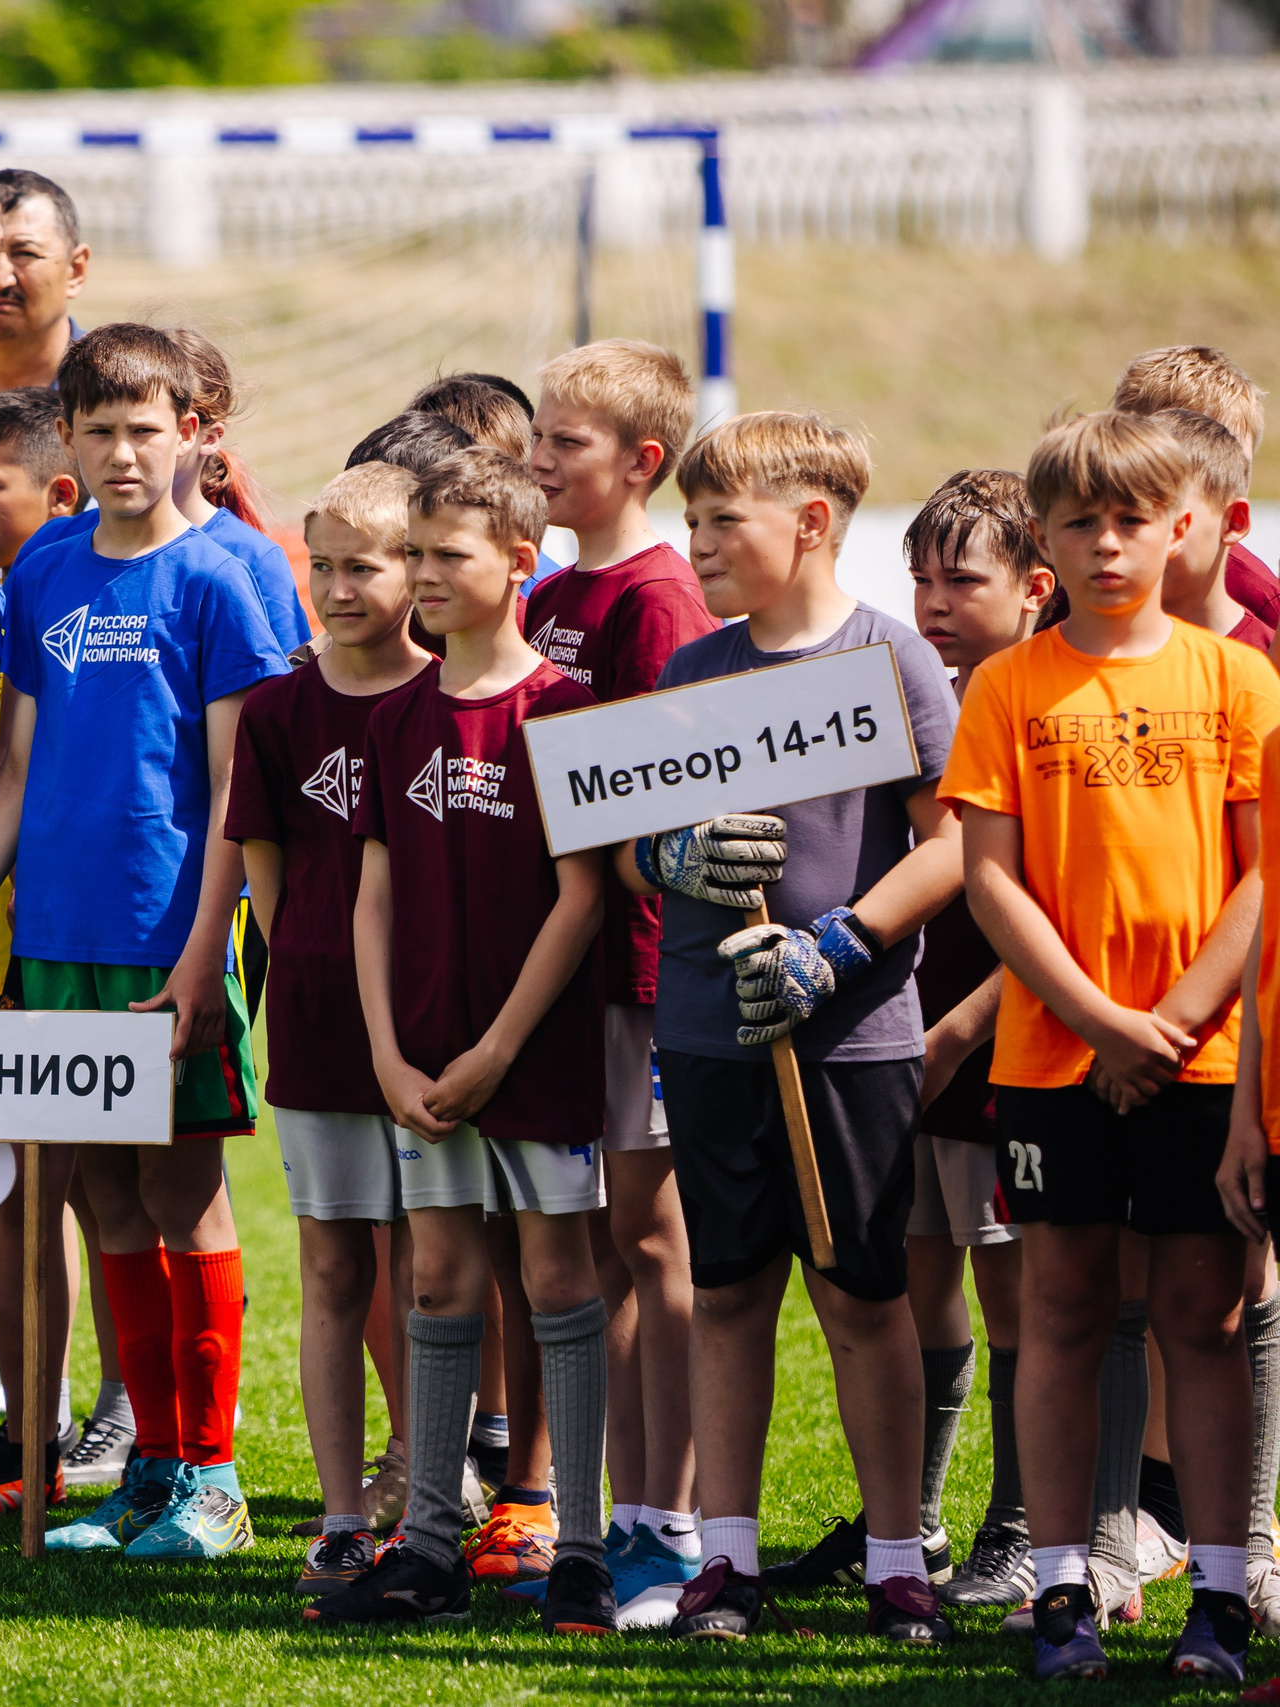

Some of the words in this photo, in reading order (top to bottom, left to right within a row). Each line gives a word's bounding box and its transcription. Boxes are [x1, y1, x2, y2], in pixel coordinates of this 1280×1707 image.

[88, 615, 148, 630] РУССКАЯ
[84, 631, 142, 646] МЕДНАЯ
[81, 647, 160, 663] КОМПАНИЯ
[567, 744, 742, 807] Метеор
[756, 704, 878, 763] 14-15
[1084, 743, 1185, 787] 2025
